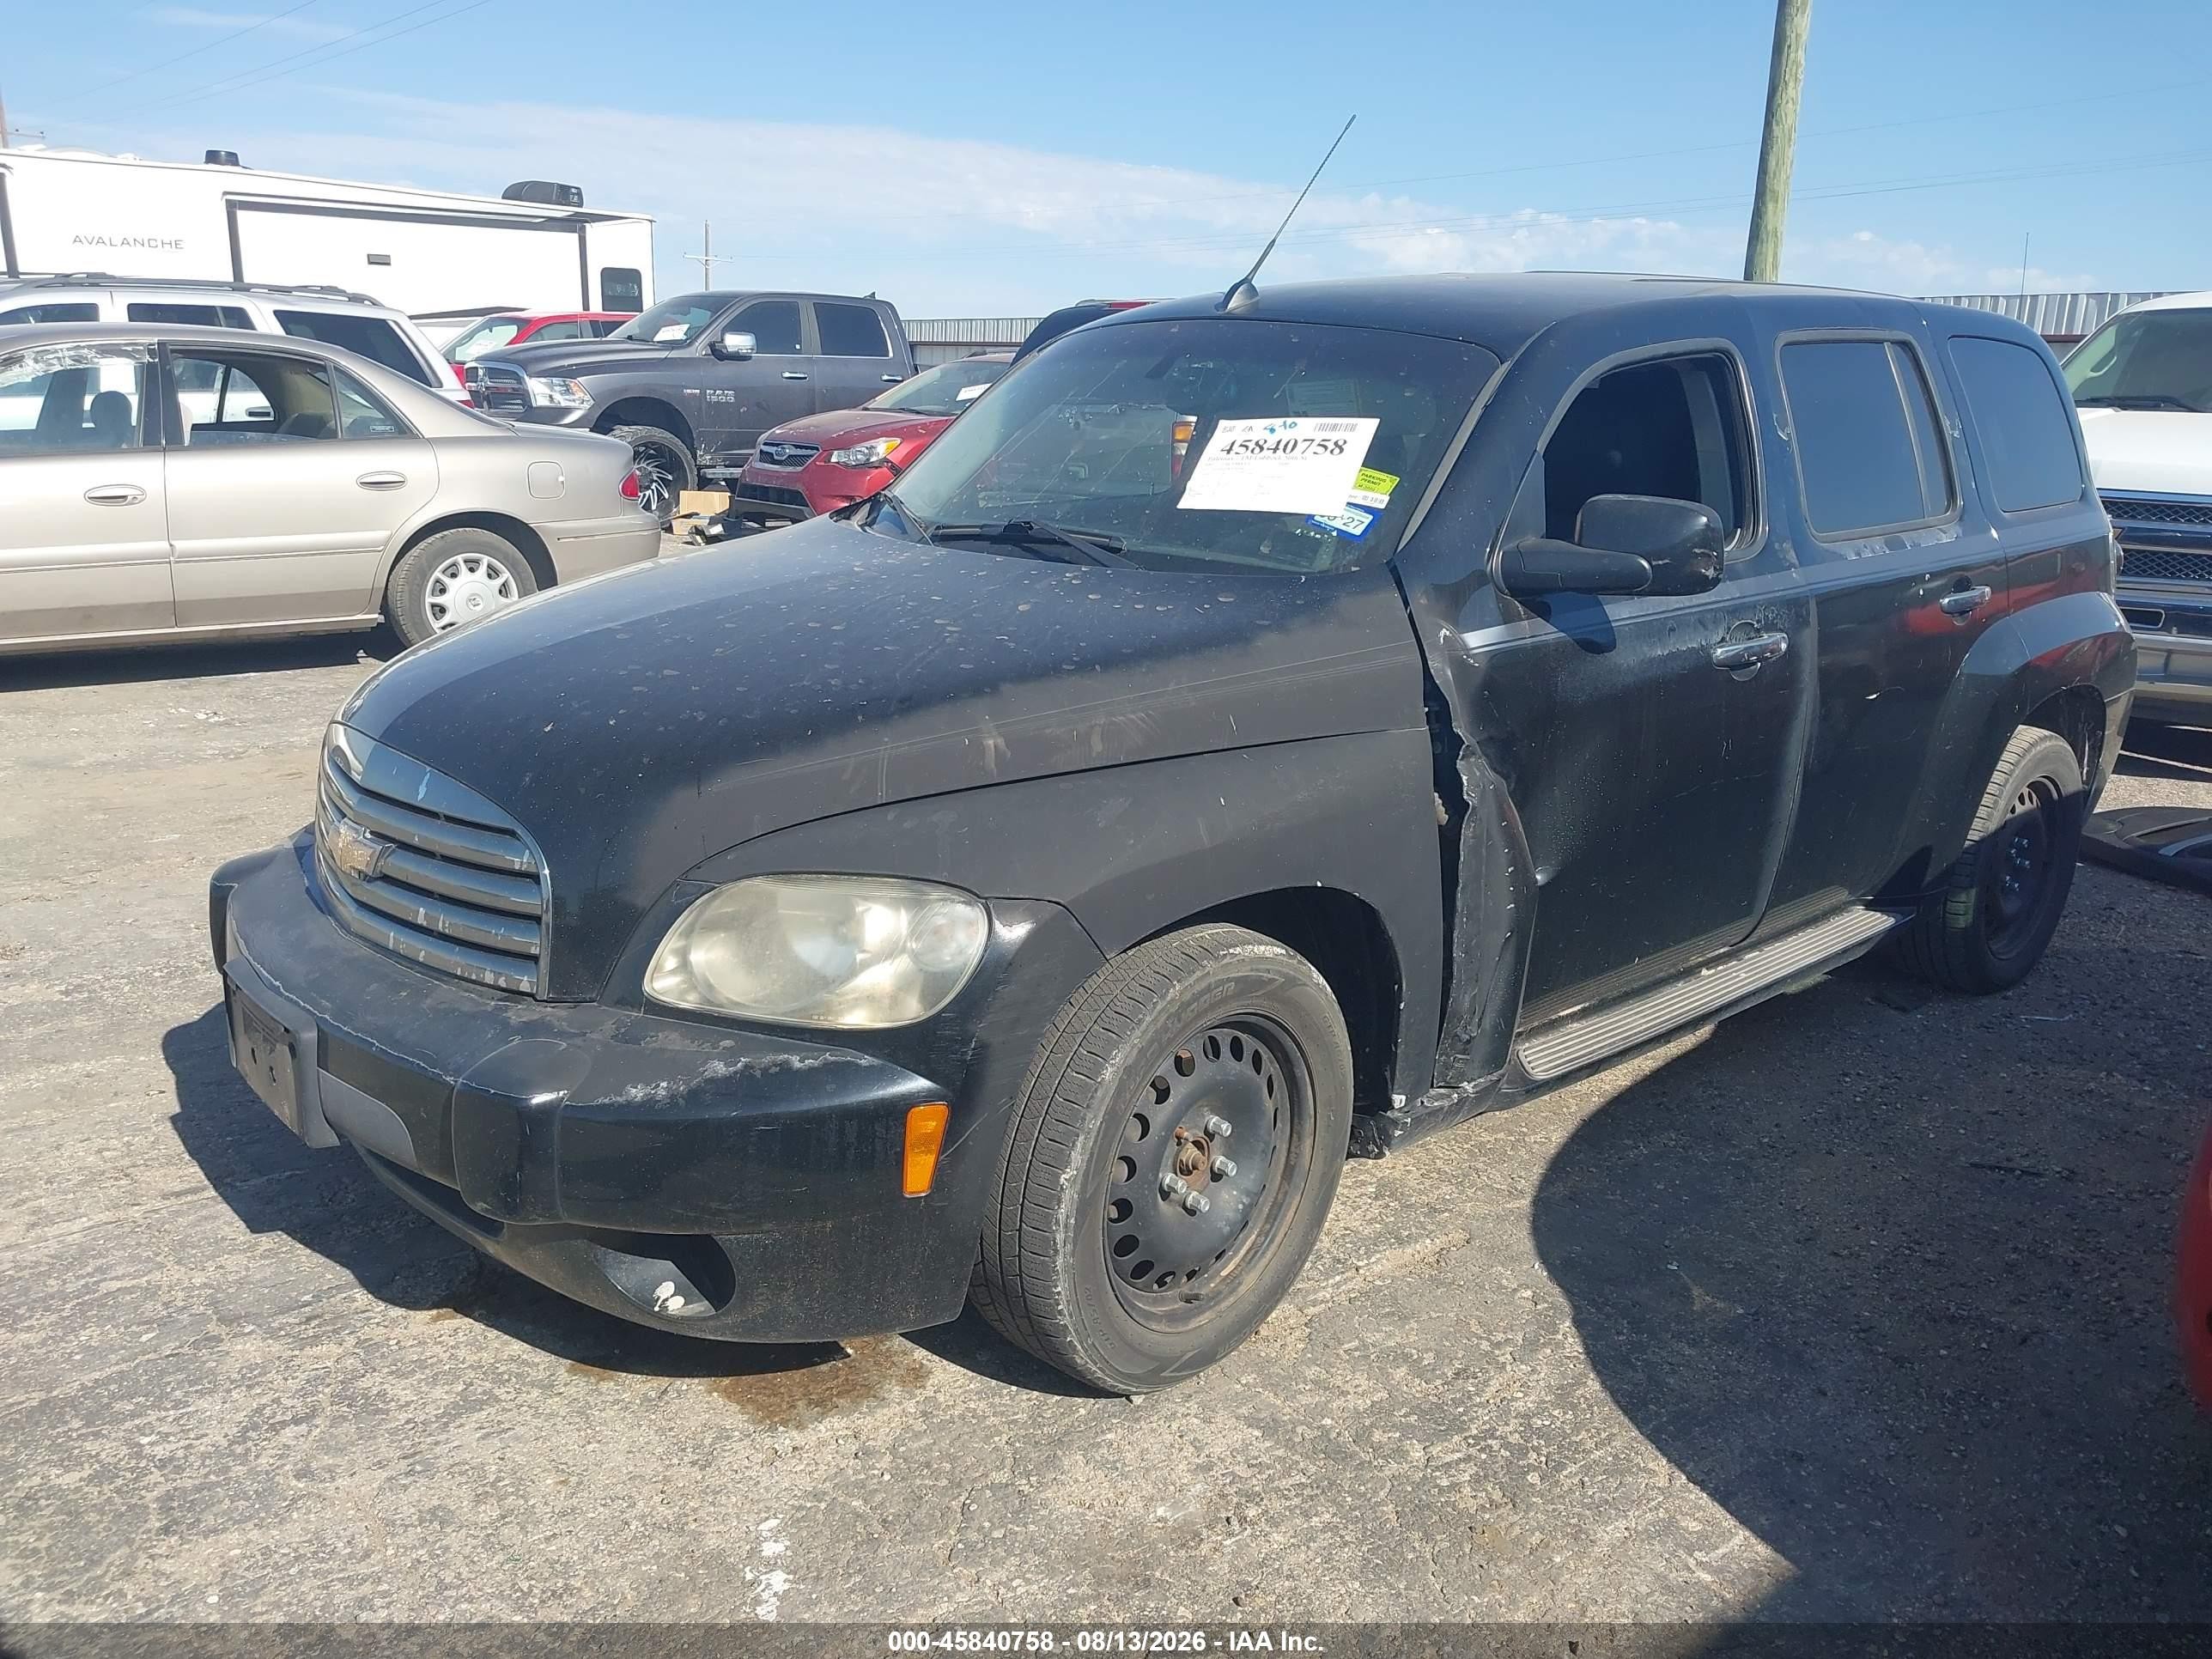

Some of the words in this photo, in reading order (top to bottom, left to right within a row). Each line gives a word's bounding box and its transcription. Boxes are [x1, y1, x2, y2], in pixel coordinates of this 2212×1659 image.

[72, 234, 185, 249] AVALANCHE
[1220, 438, 1348, 456] 45840758
[1360, 477, 1382, 486] PERMIT
[1361, 472, 1387, 483] PARKING
